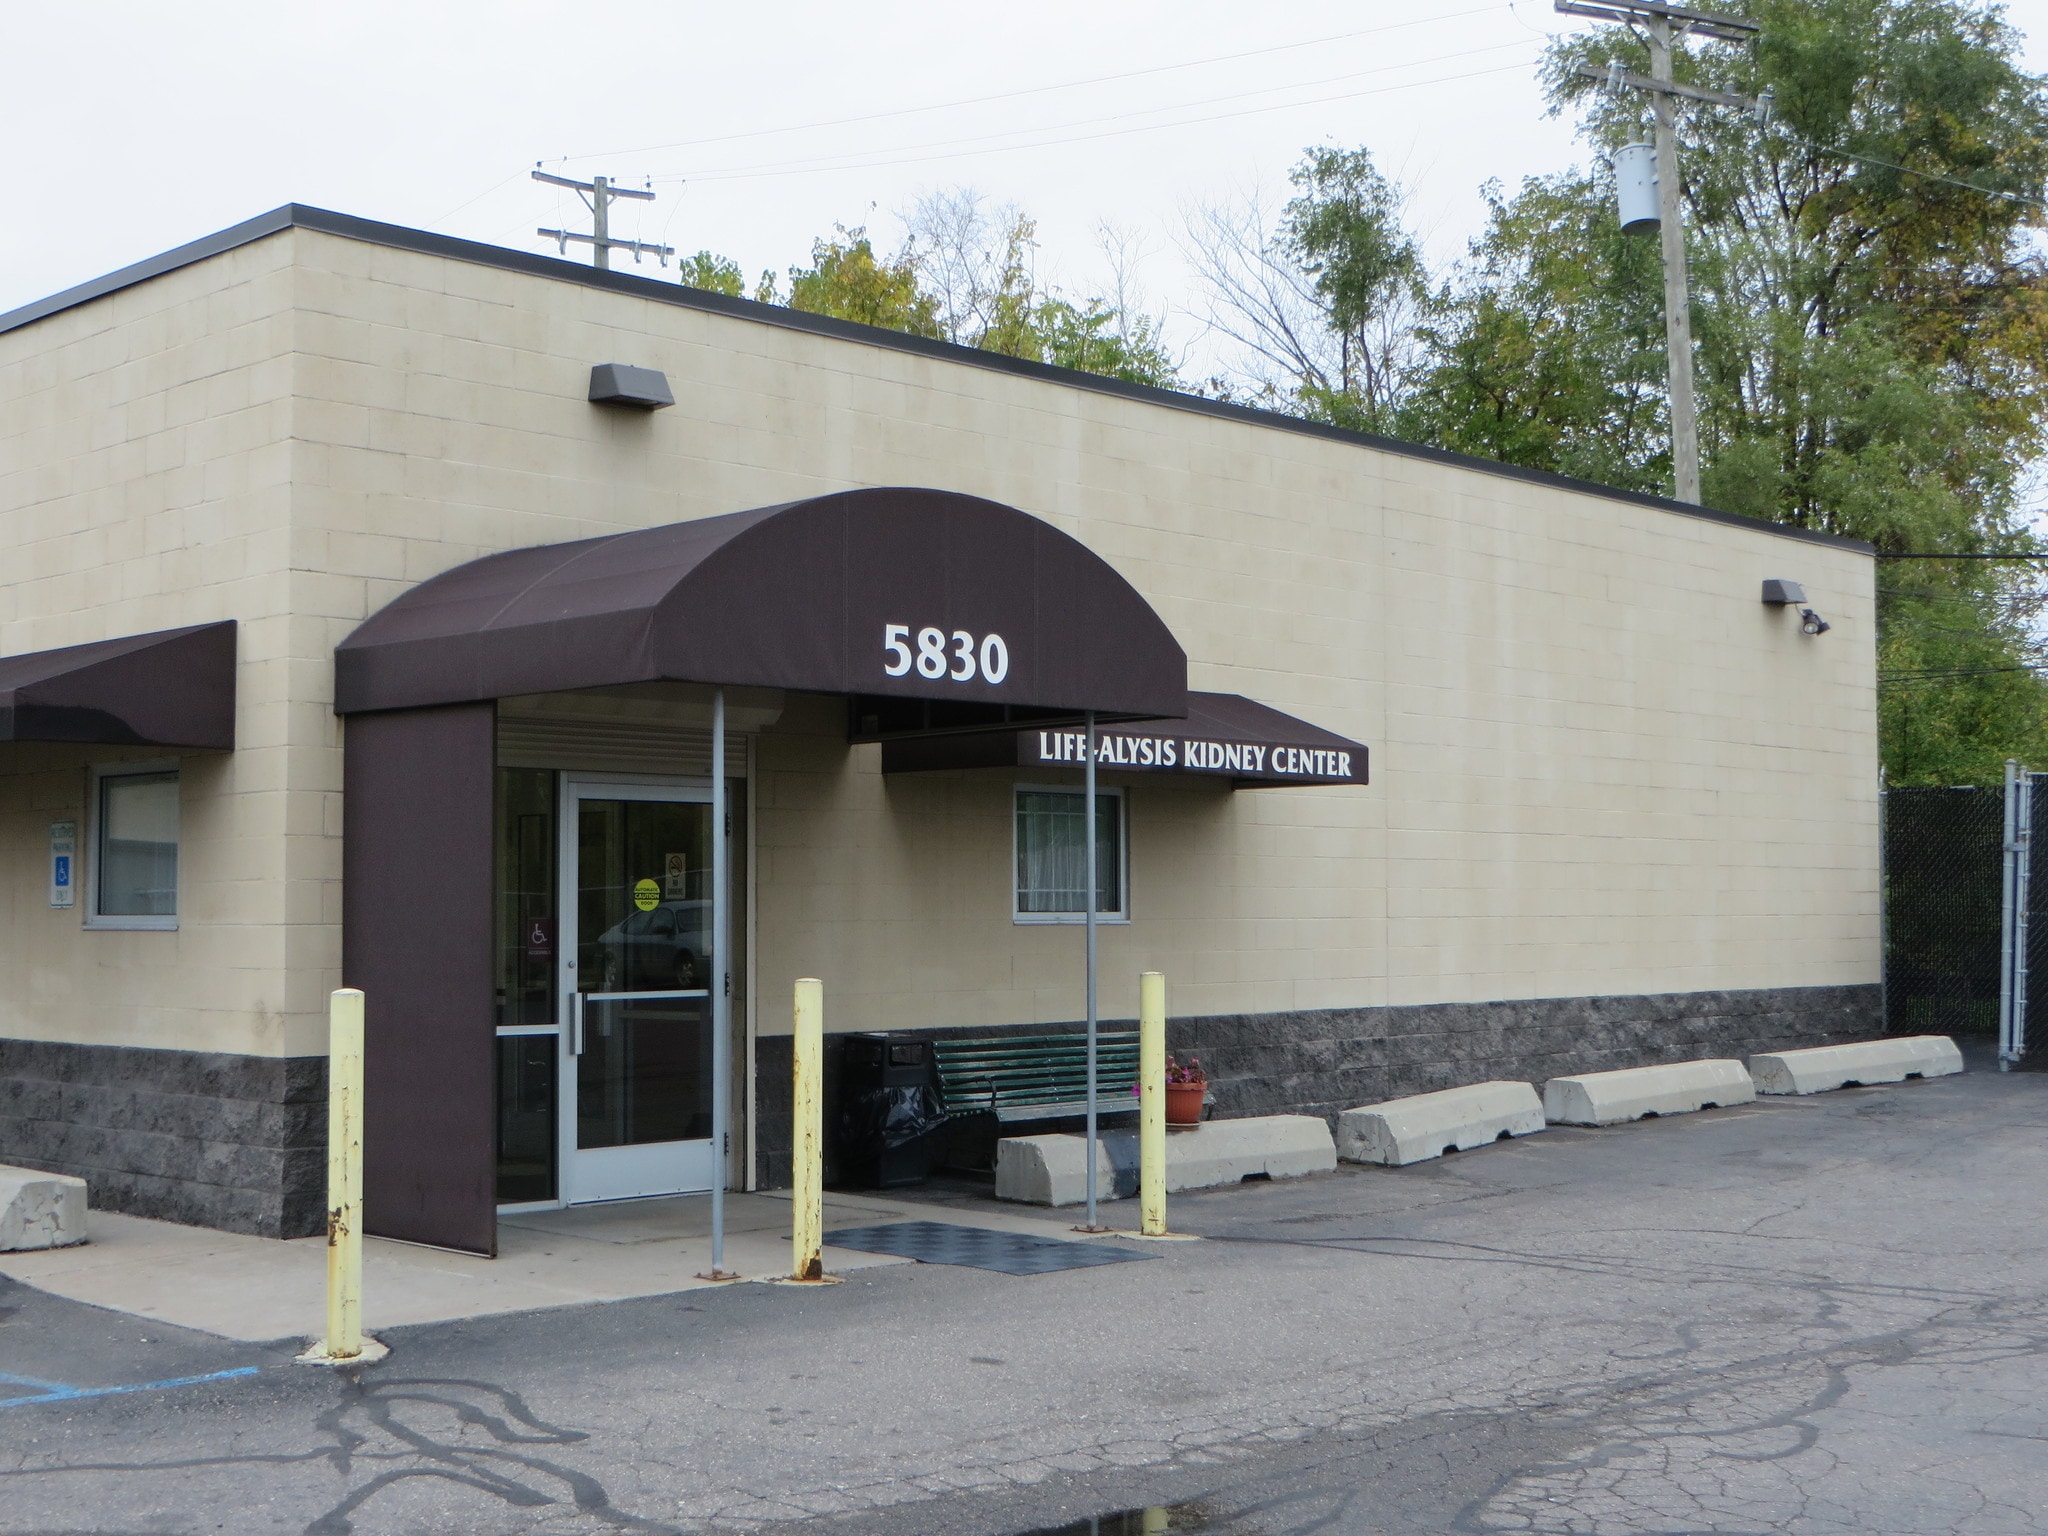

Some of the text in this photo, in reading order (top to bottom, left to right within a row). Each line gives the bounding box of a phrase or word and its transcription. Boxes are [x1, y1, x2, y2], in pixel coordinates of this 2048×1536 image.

[884, 623, 1009, 685] 5830
[1184, 740, 1267, 771] KIDNEY
[1271, 747, 1352, 777] CENTER
